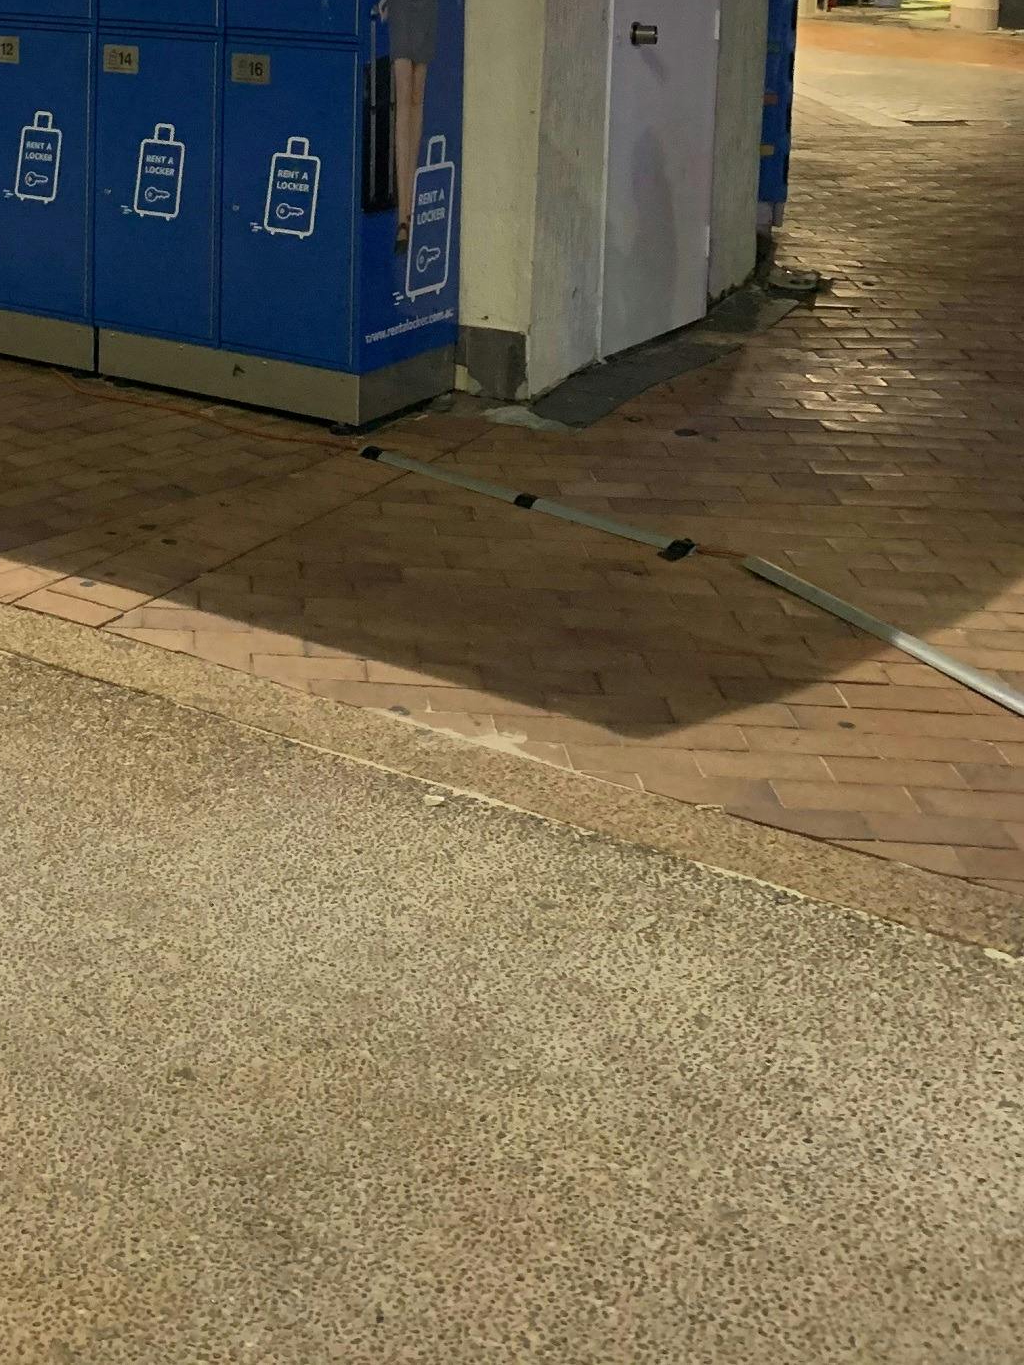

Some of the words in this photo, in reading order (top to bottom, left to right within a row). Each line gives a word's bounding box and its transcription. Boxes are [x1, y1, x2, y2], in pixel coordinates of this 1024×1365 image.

[1, 42, 14, 56] 12
[118, 52, 132, 65] 14
[248, 62, 263, 77] 16
[145, 154, 166, 164] RENT
[144, 166, 175, 177] LOCKER
[277, 169, 299, 180] RENT
[276, 182, 311, 193] LOCKER
[418, 191, 438, 206] RENT
[417, 207, 446, 225] LOCKER
